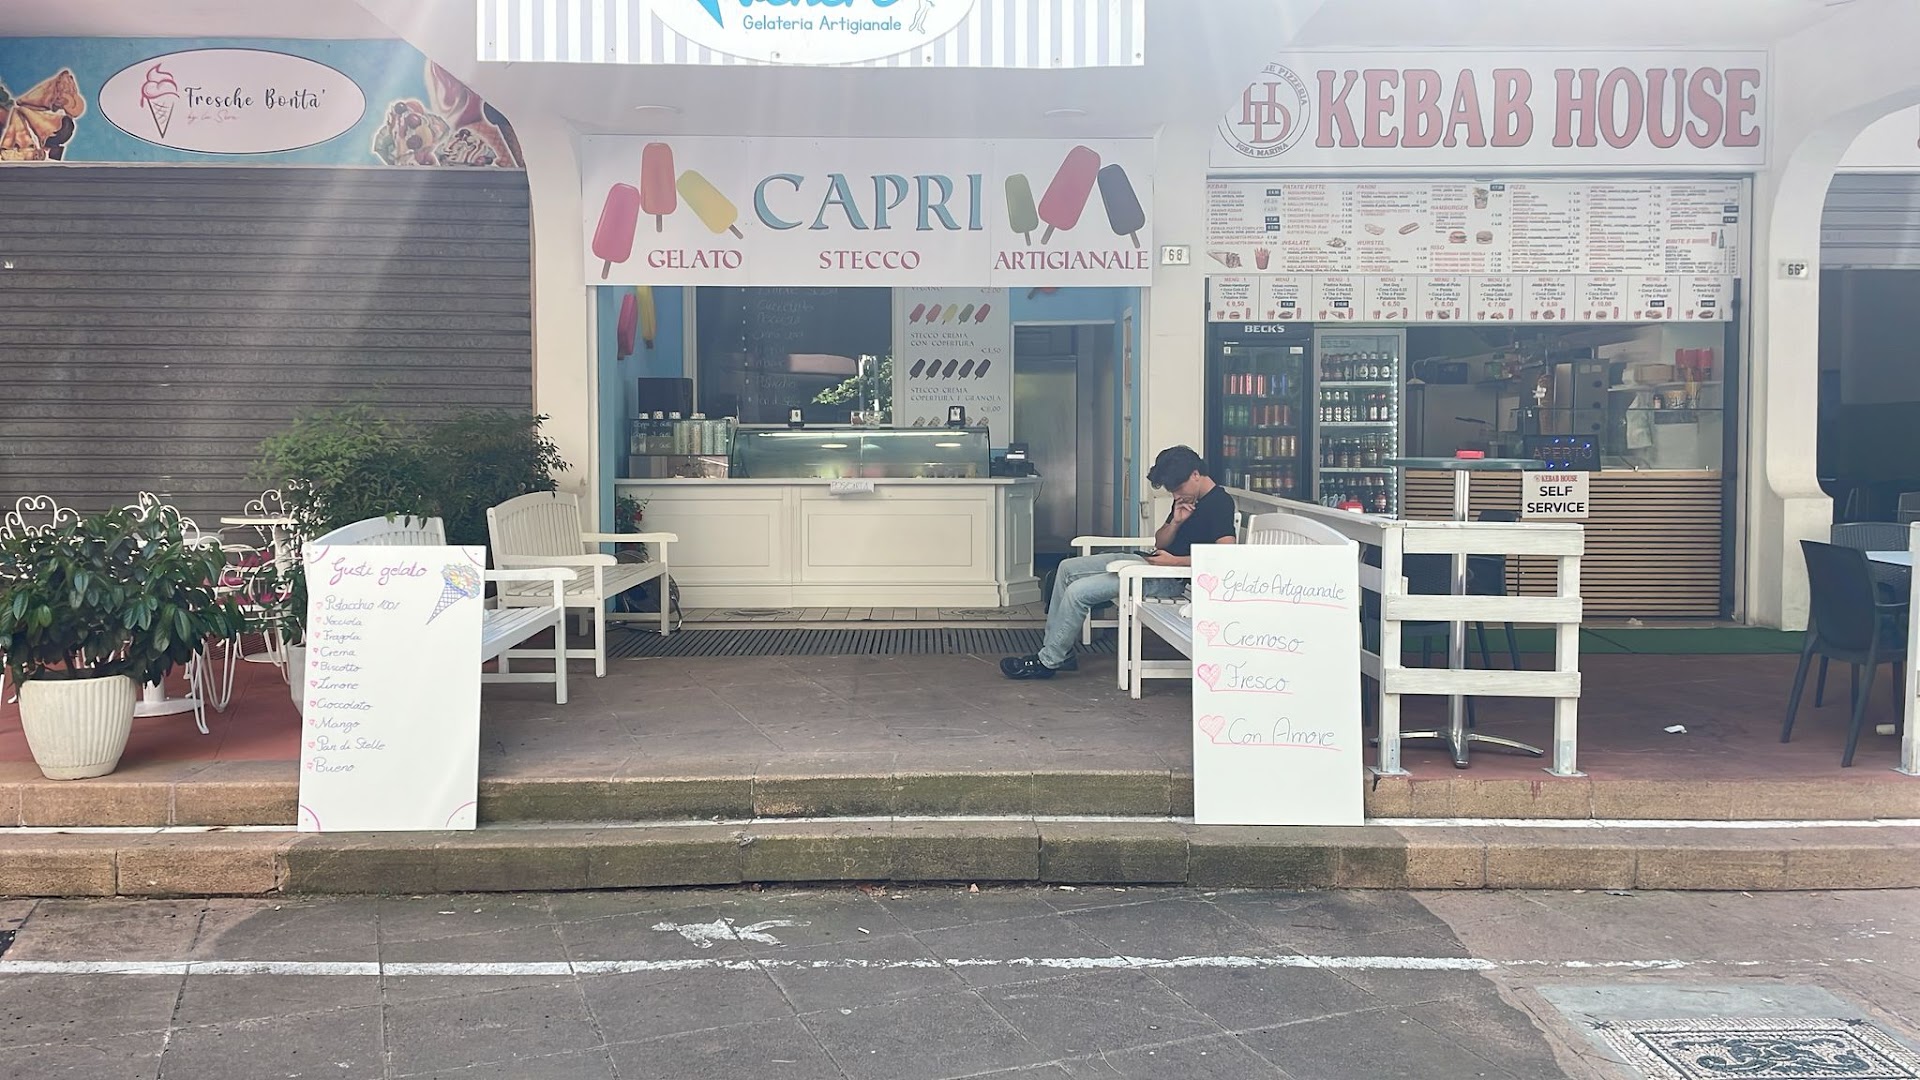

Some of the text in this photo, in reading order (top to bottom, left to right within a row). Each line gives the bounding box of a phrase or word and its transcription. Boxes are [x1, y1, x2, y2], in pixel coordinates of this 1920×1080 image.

[742, 15, 902, 34] Gelateria Artigianale
[1278, 67, 1308, 106] PIZZERIA
[184, 86, 254, 108] Fresche
[1315, 67, 1761, 150] KEBAB HOUSE
[1235, 142, 1290, 157] IGEA MARINA
[752, 173, 983, 232] CAPRI
[647, 249, 742, 272] GELATO
[819, 249, 921, 272] STECCO
[993, 249, 1151, 272] ARTIGIANALE
[1168, 249, 1183, 262] 68
[1244, 324, 1285, 333] BECK'S
[1540, 486, 1573, 496] SELF
[1527, 502, 1585, 513] SERVICE
[329, 556, 428, 586] Gusti gelato
[1222, 570, 1347, 604] Gelato Artigianale
[325, 594, 375, 611] Pistacchio
[322, 616, 364, 627] Nocciola
[322, 630, 362, 644] Fragola
[1222, 621, 1304, 653] Cremoso
[320, 646, 357, 658] Crema
[320, 661, 363, 673] Biscotto
[316, 676, 360, 690] Limone
[1225, 661, 1290, 692] Fresco
[316, 698, 374, 711] Cioccolato
[315, 718, 361, 733] Mango
[1228, 716, 1336, 746] Con Amore
[316, 735, 336, 751] Pan
[354, 738, 386, 751] Stelle
[314, 756, 355, 774] Bueno
